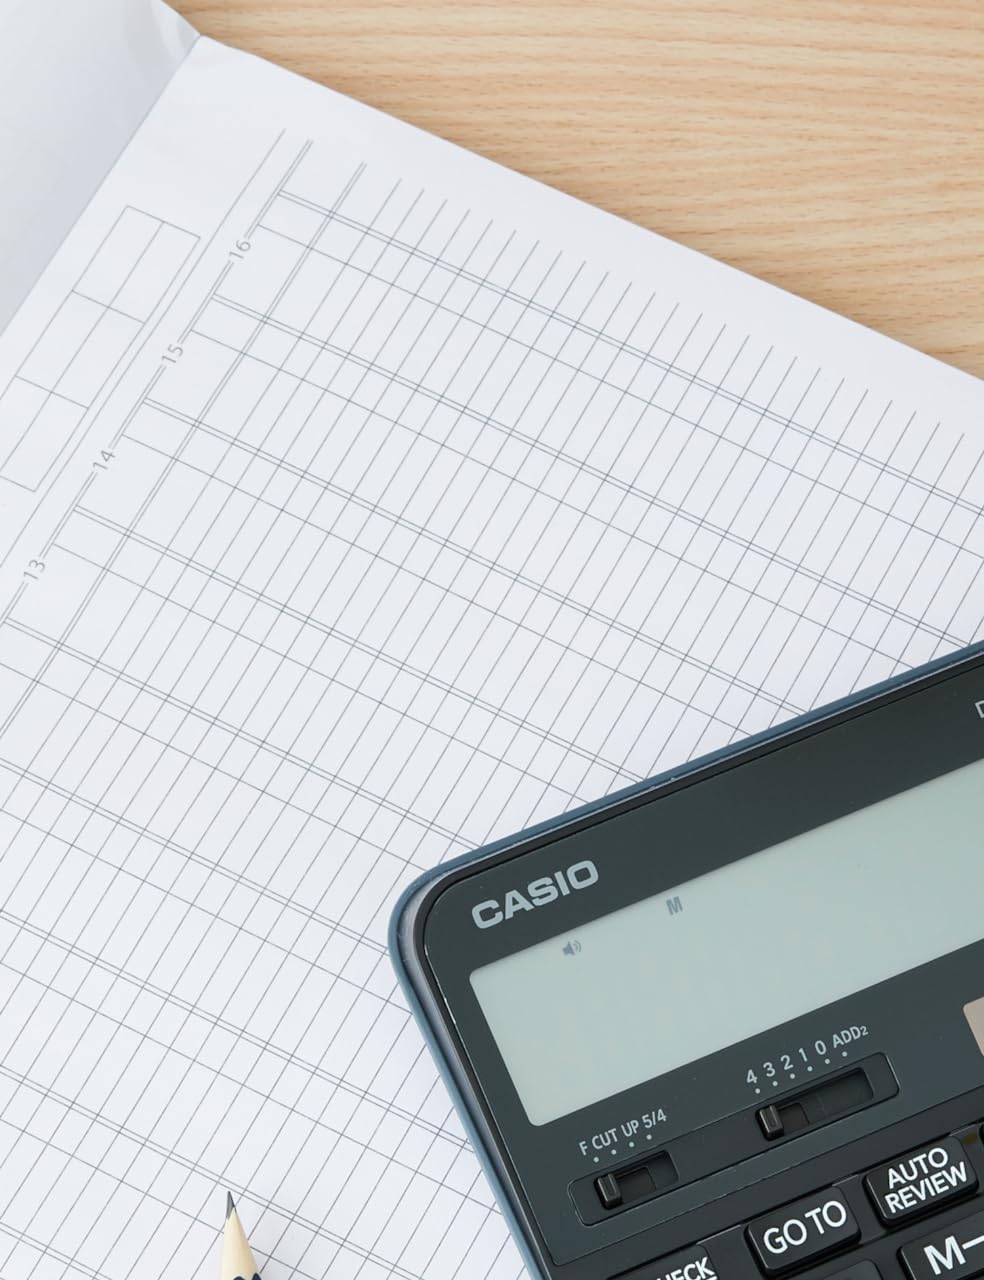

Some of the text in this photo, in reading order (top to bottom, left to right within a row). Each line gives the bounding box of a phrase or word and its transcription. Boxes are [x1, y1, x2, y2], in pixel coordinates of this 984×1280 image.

[229, 239, 251, 261] 16
[161, 344, 184, 365] 15
[93, 448, 116, 470] 14
[24, 559, 45, 580] 13
[471, 860, 599, 929] CASIO
[665, 895, 684, 916] M
[746, 1069, 757, 1084] 4
[763, 1062, 776, 1077] 3
[781, 1055, 794, 1070] 2
[798, 1048, 809, 1062] 1
[815, 1040, 826, 1055] 0
[578, 1108, 667, 1156] F CUT UP 5/4
[887, 1146, 949, 1189] AUTO
[884, 1161, 968, 1214] REVIEW
